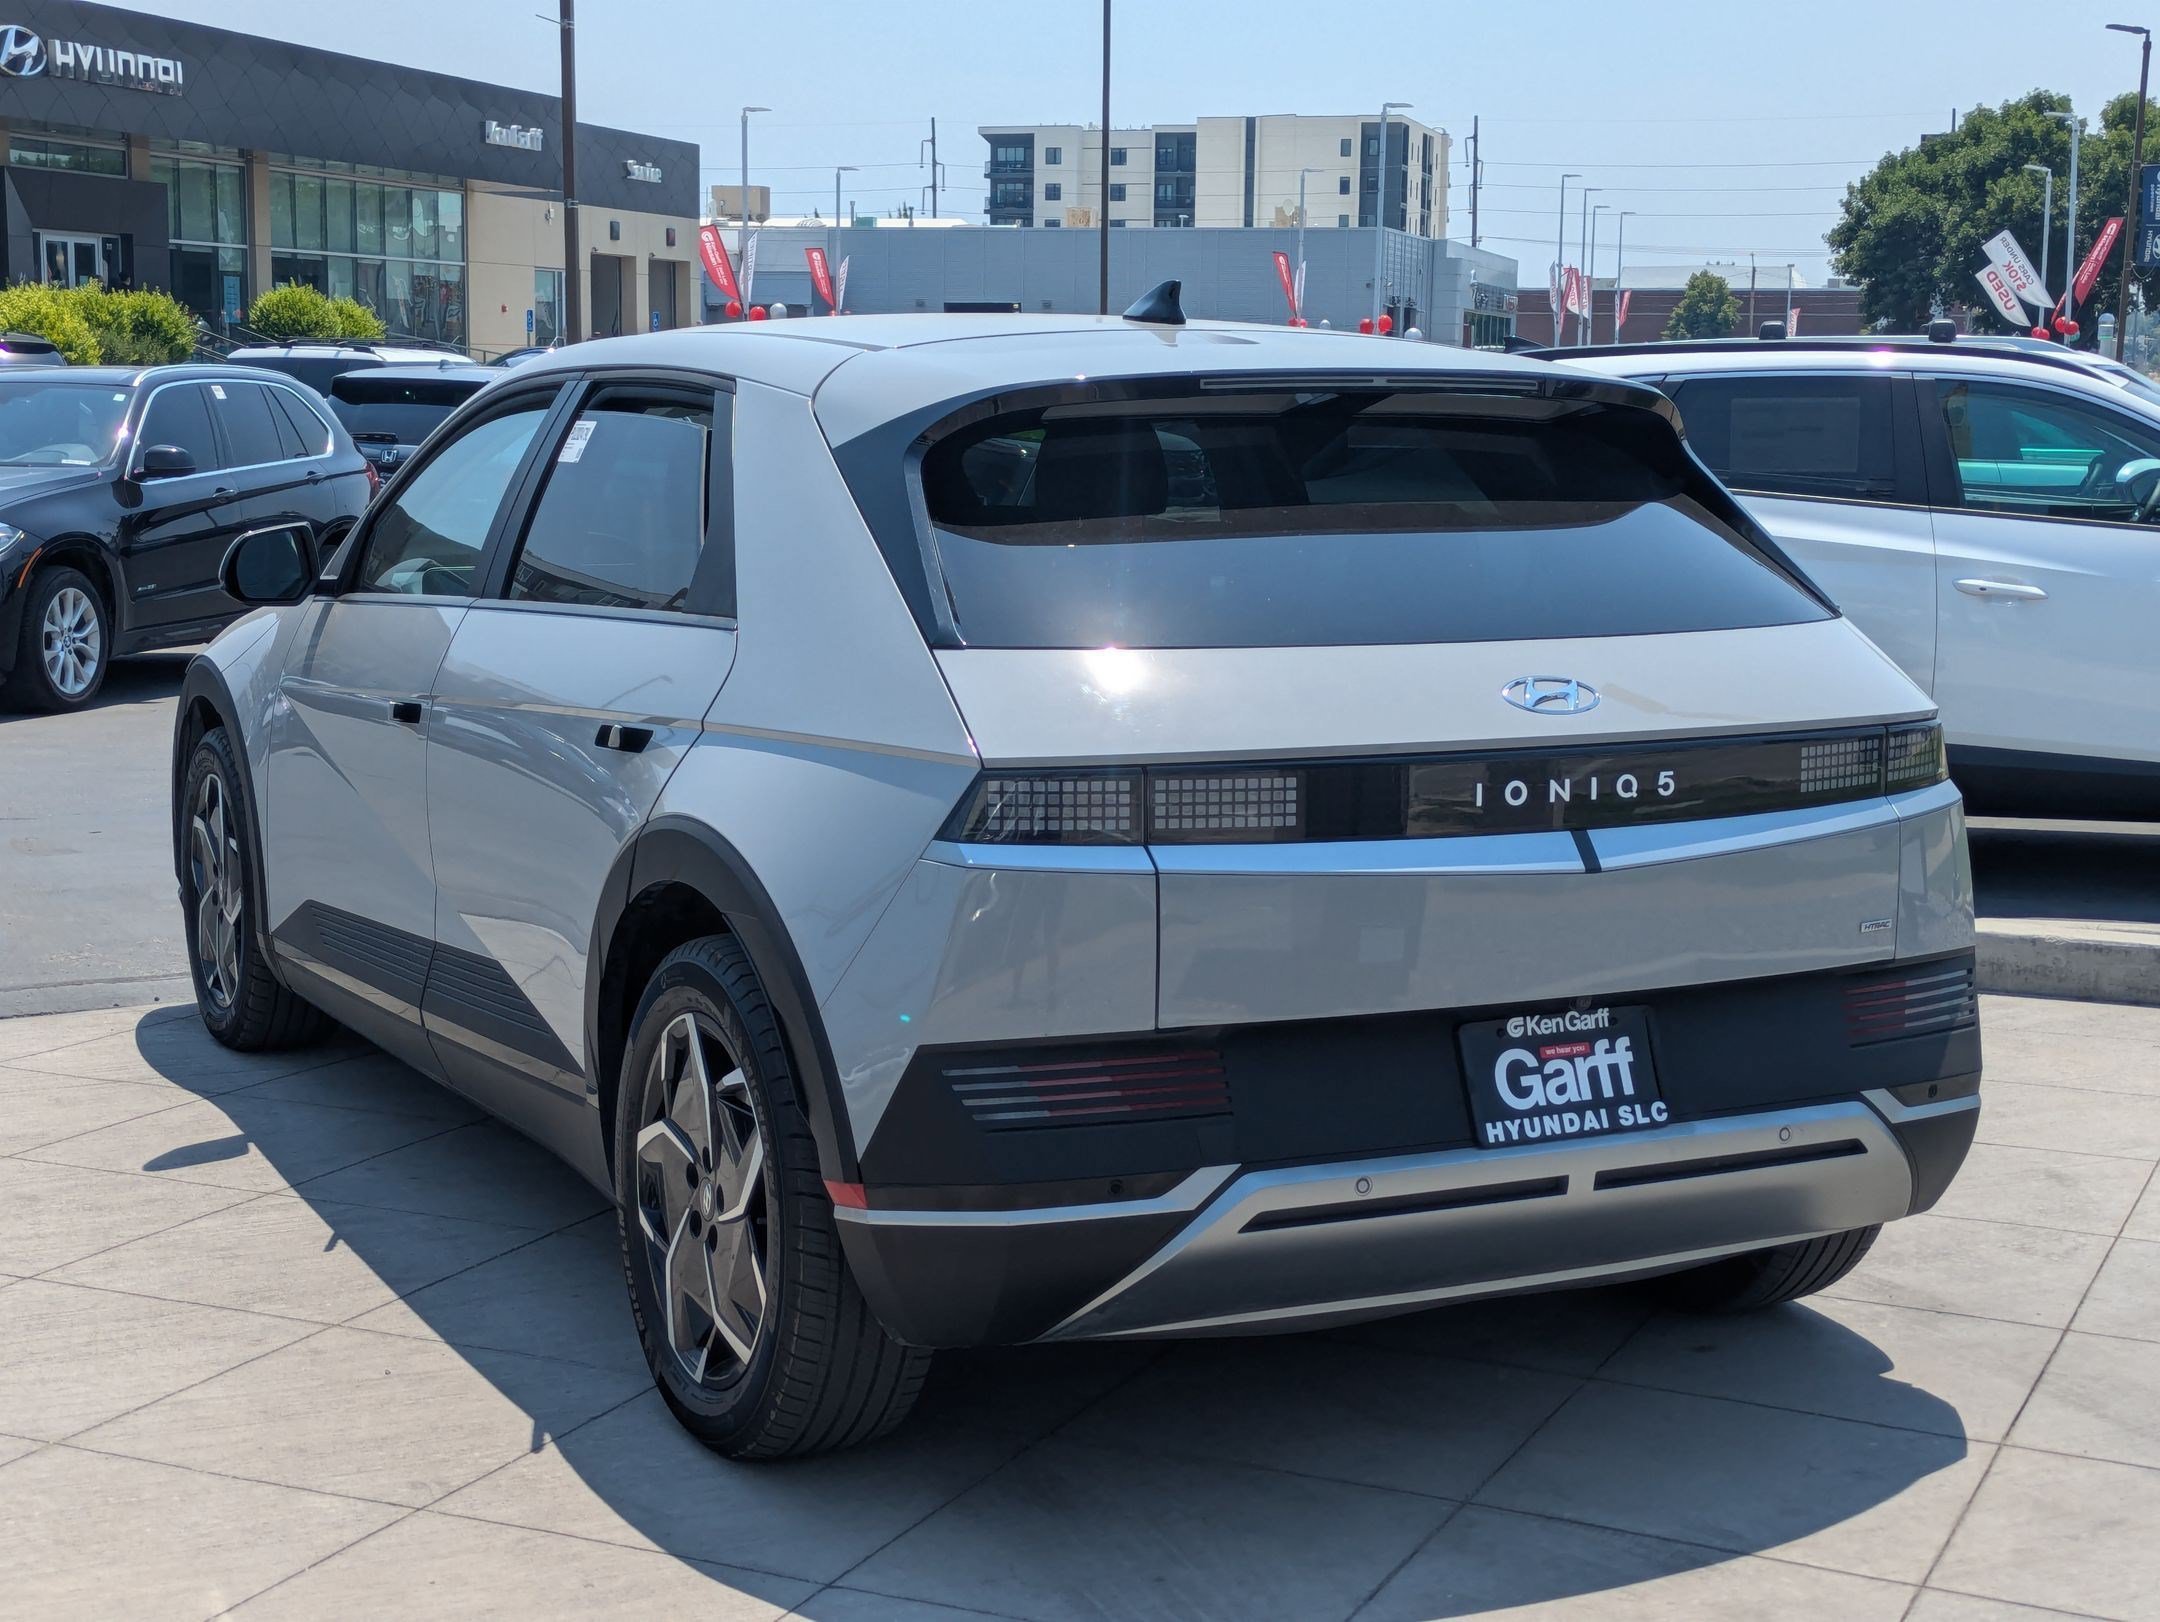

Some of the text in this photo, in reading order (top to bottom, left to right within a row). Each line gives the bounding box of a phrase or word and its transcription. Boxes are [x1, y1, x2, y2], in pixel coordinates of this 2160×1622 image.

[53, 39, 183, 86] HYUNDAI
[1556, 1045, 1572, 1054] hear
[1572, 1044, 1586, 1054] you
[1494, 1036, 1635, 1111] Garff
[1485, 1101, 1668, 1144] HYUNDAI SLC
